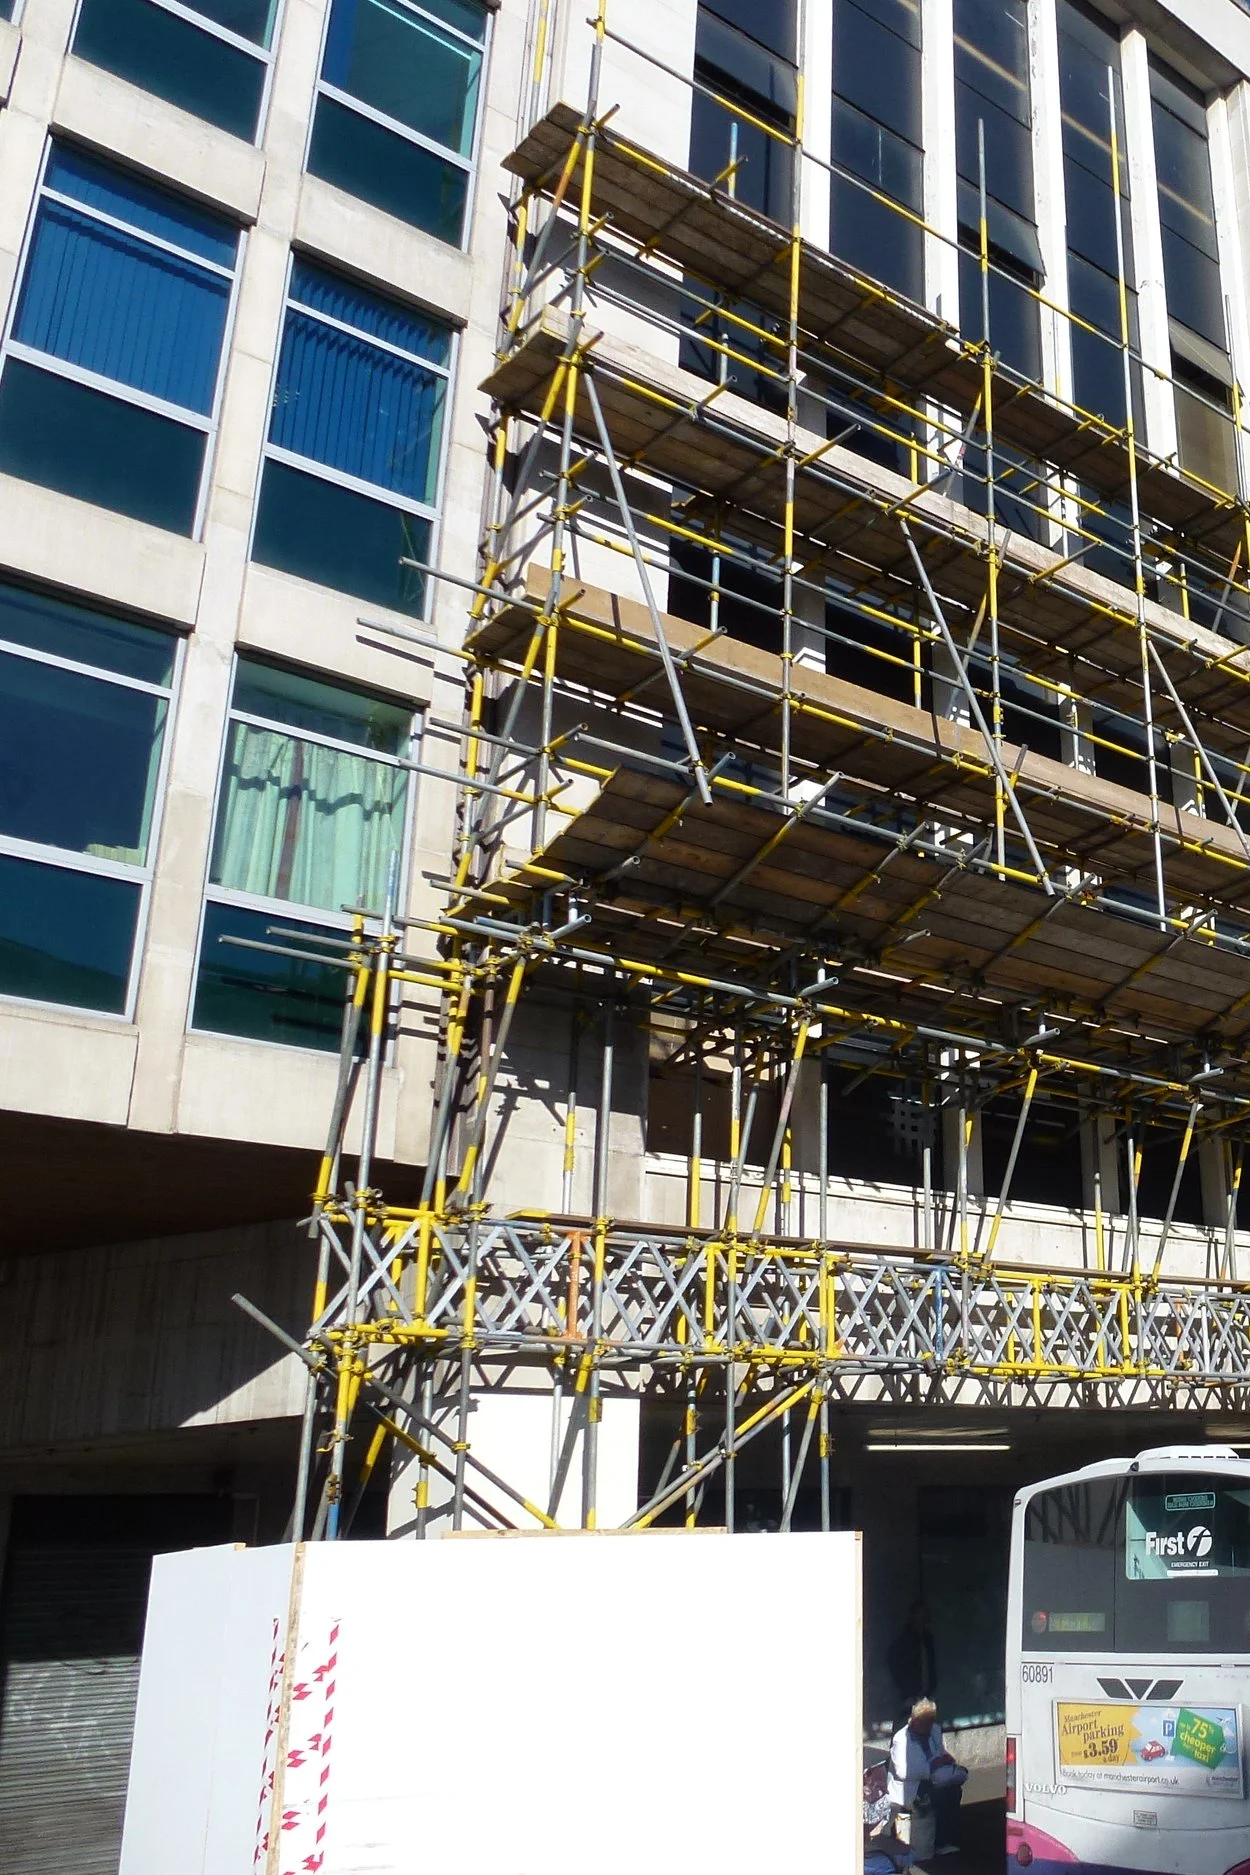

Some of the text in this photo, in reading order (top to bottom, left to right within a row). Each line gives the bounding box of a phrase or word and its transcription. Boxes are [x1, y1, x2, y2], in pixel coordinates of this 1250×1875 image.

[1145, 1531, 1185, 1555] First
[1022, 1664, 1053, 1684] 60891
[1064, 1711, 1102, 1723] Manchester
[1062, 1719, 1099, 1736] Airport
[1083, 1724, 1124, 1744] parking
[1180, 1731, 1216, 1754] cheaper
[1194, 1749, 1209, 1763] taxi
[1078, 1769, 1096, 1780] today
[1103, 1771, 1180, 1785] manchesterairport.co.uk
[1024, 1782, 1068, 1795] VOLVO
